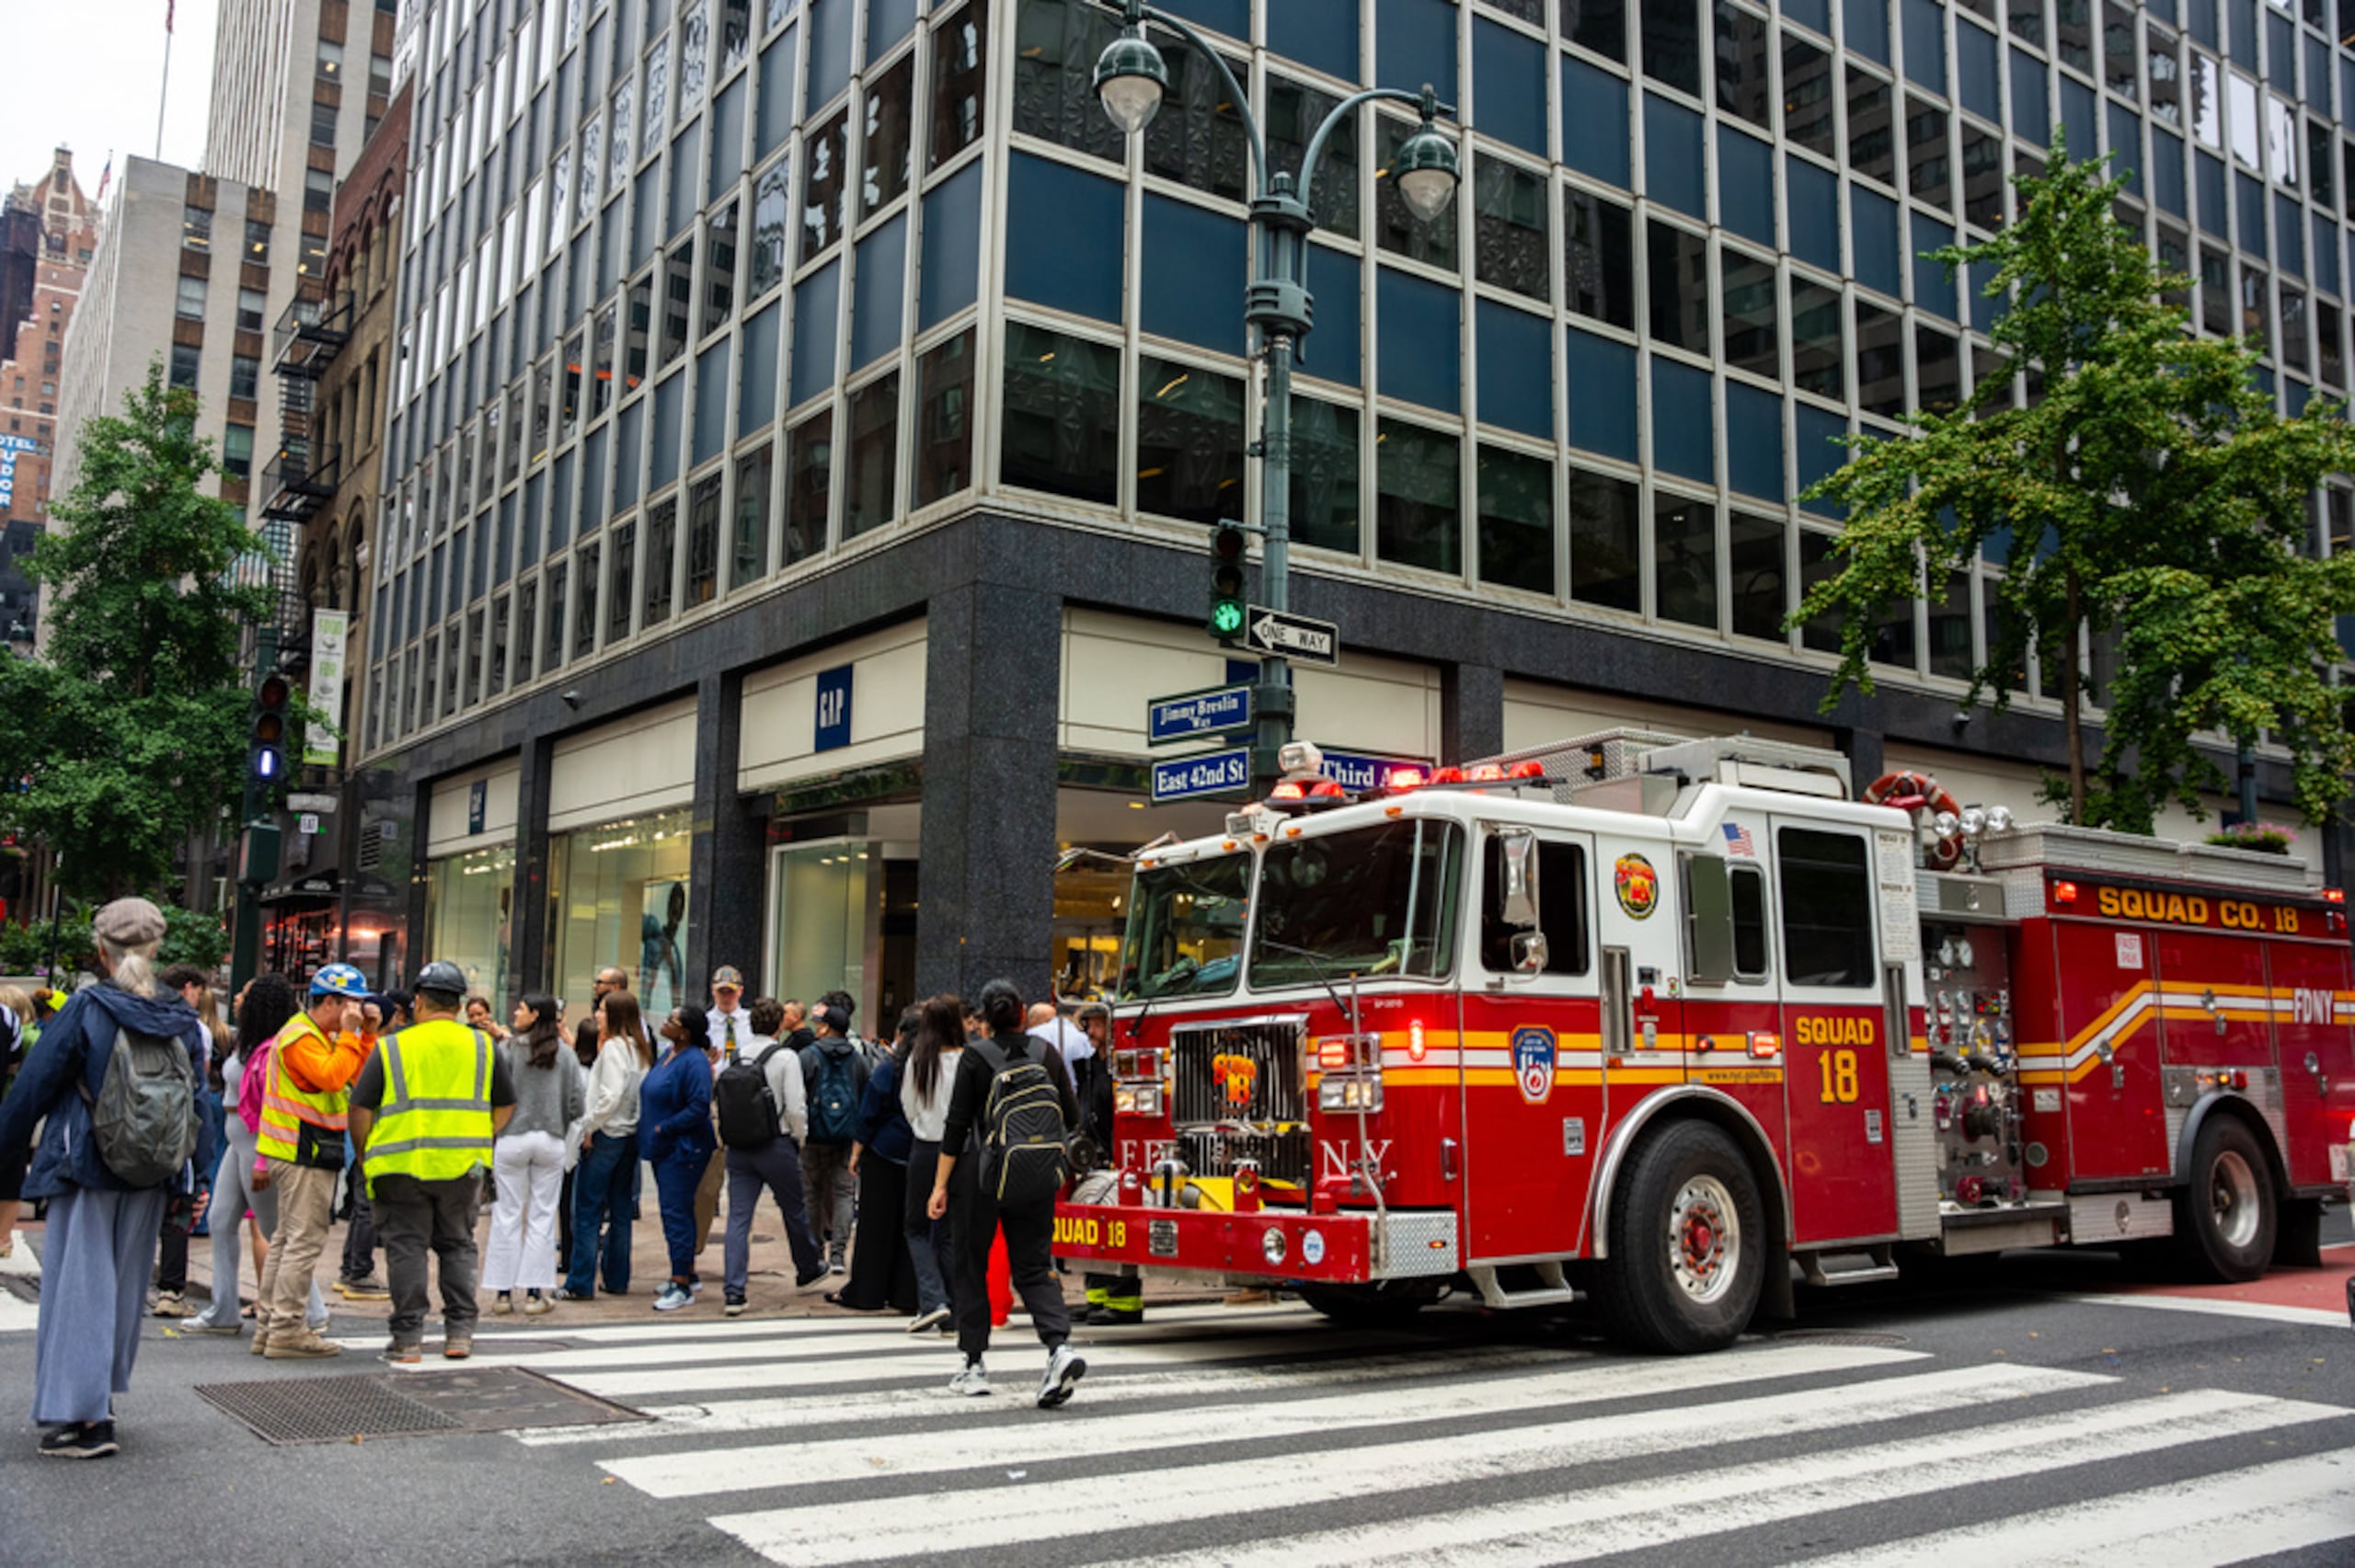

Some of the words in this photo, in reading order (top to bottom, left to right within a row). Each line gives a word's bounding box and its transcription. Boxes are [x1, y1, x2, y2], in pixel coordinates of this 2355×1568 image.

[1260, 623, 1286, 643] ONE
[1298, 631, 1326, 647] WAY
[819, 687, 844, 728] GAP
[1160, 705, 1197, 726] Jimmy
[1198, 694, 1239, 715] Breslin
[1190, 716, 1212, 728] Way
[1157, 770, 1189, 793] East
[1190, 760, 1225, 787] 42nd
[1227, 757, 1245, 783] St
[1322, 760, 1374, 787] Third
[2098, 886, 2208, 924] SQUAD
[2219, 899, 2267, 931] CO.
[2273, 906, 2299, 933] 18
[2294, 988, 2333, 1024] FDNY
[1796, 1015, 1874, 1046] SQUAD
[1818, 1048, 1858, 1104] 18
[1107, 1219, 1126, 1248] 18
